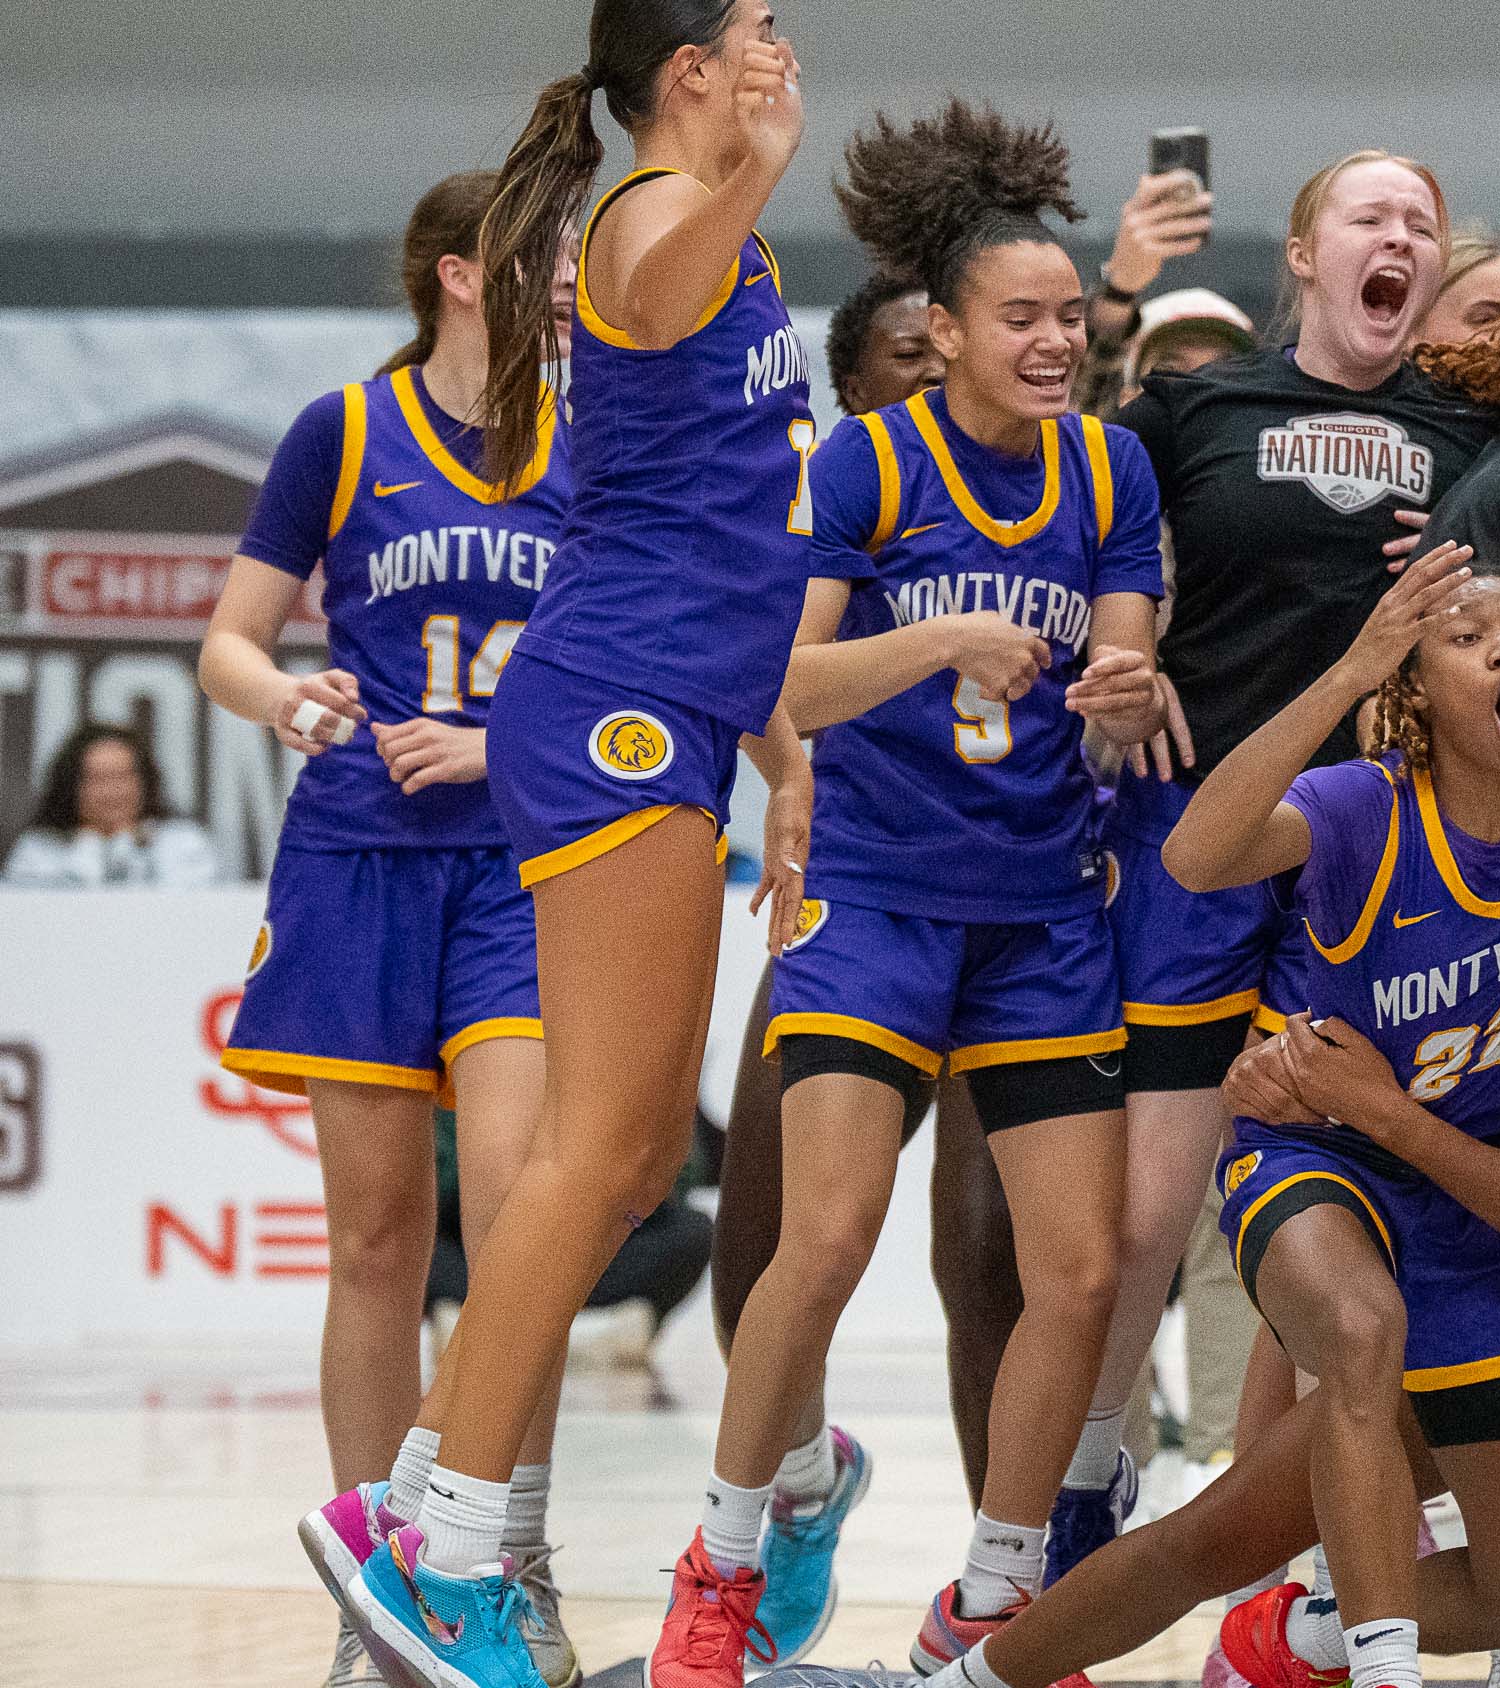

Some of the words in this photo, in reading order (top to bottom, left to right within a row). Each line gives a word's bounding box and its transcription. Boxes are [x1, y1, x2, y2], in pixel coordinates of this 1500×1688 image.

[1325, 424, 1386, 437] CHIPOTLE
[1265, 434, 1426, 494] NATIONALS
[421, 614, 528, 713] 14
